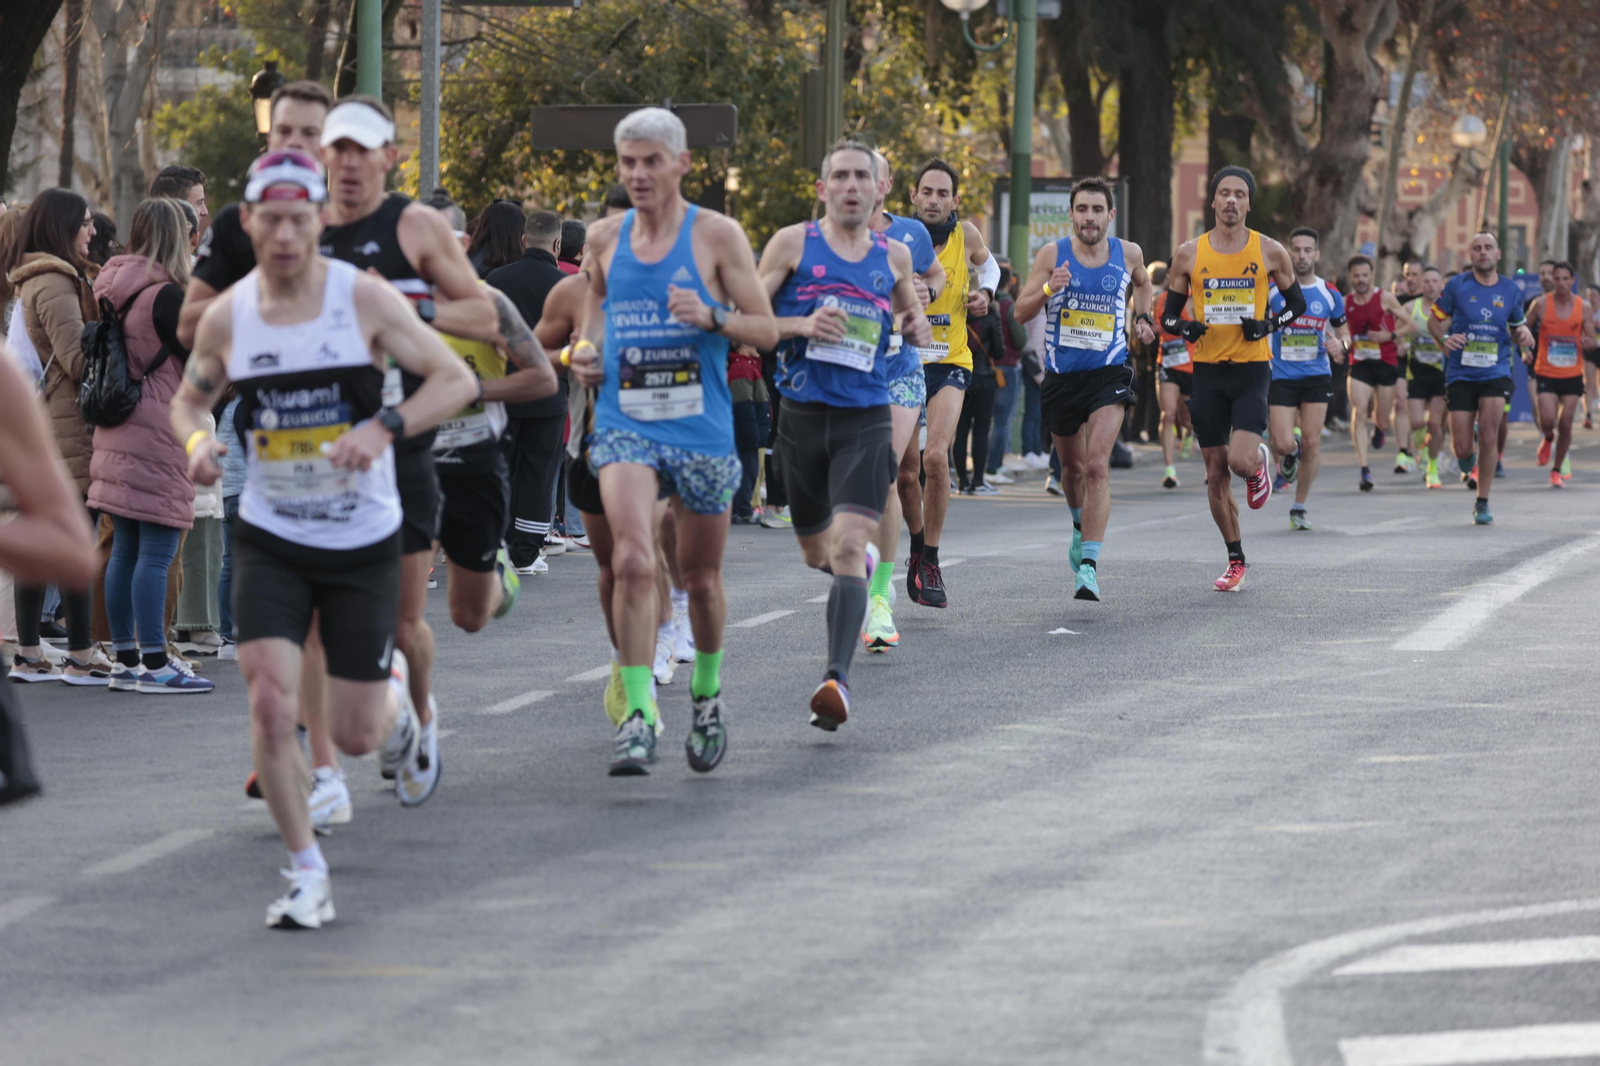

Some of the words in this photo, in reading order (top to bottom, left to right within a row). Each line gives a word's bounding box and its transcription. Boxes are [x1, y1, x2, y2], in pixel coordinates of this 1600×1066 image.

[1220, 278, 1249, 288] ZURICH
[1222, 295, 1236, 303] 692
[840, 301, 877, 318] ZURICH
[1080, 302, 1110, 313] ZURICH
[612, 312, 661, 328] SEVILLA
[1080, 317, 1095, 327] 620
[1070, 328, 1103, 339] ITURRASPE
[644, 347, 691, 361] ZURICH
[645, 371, 674, 387] 2577
[280, 408, 340, 428] ZURICH
